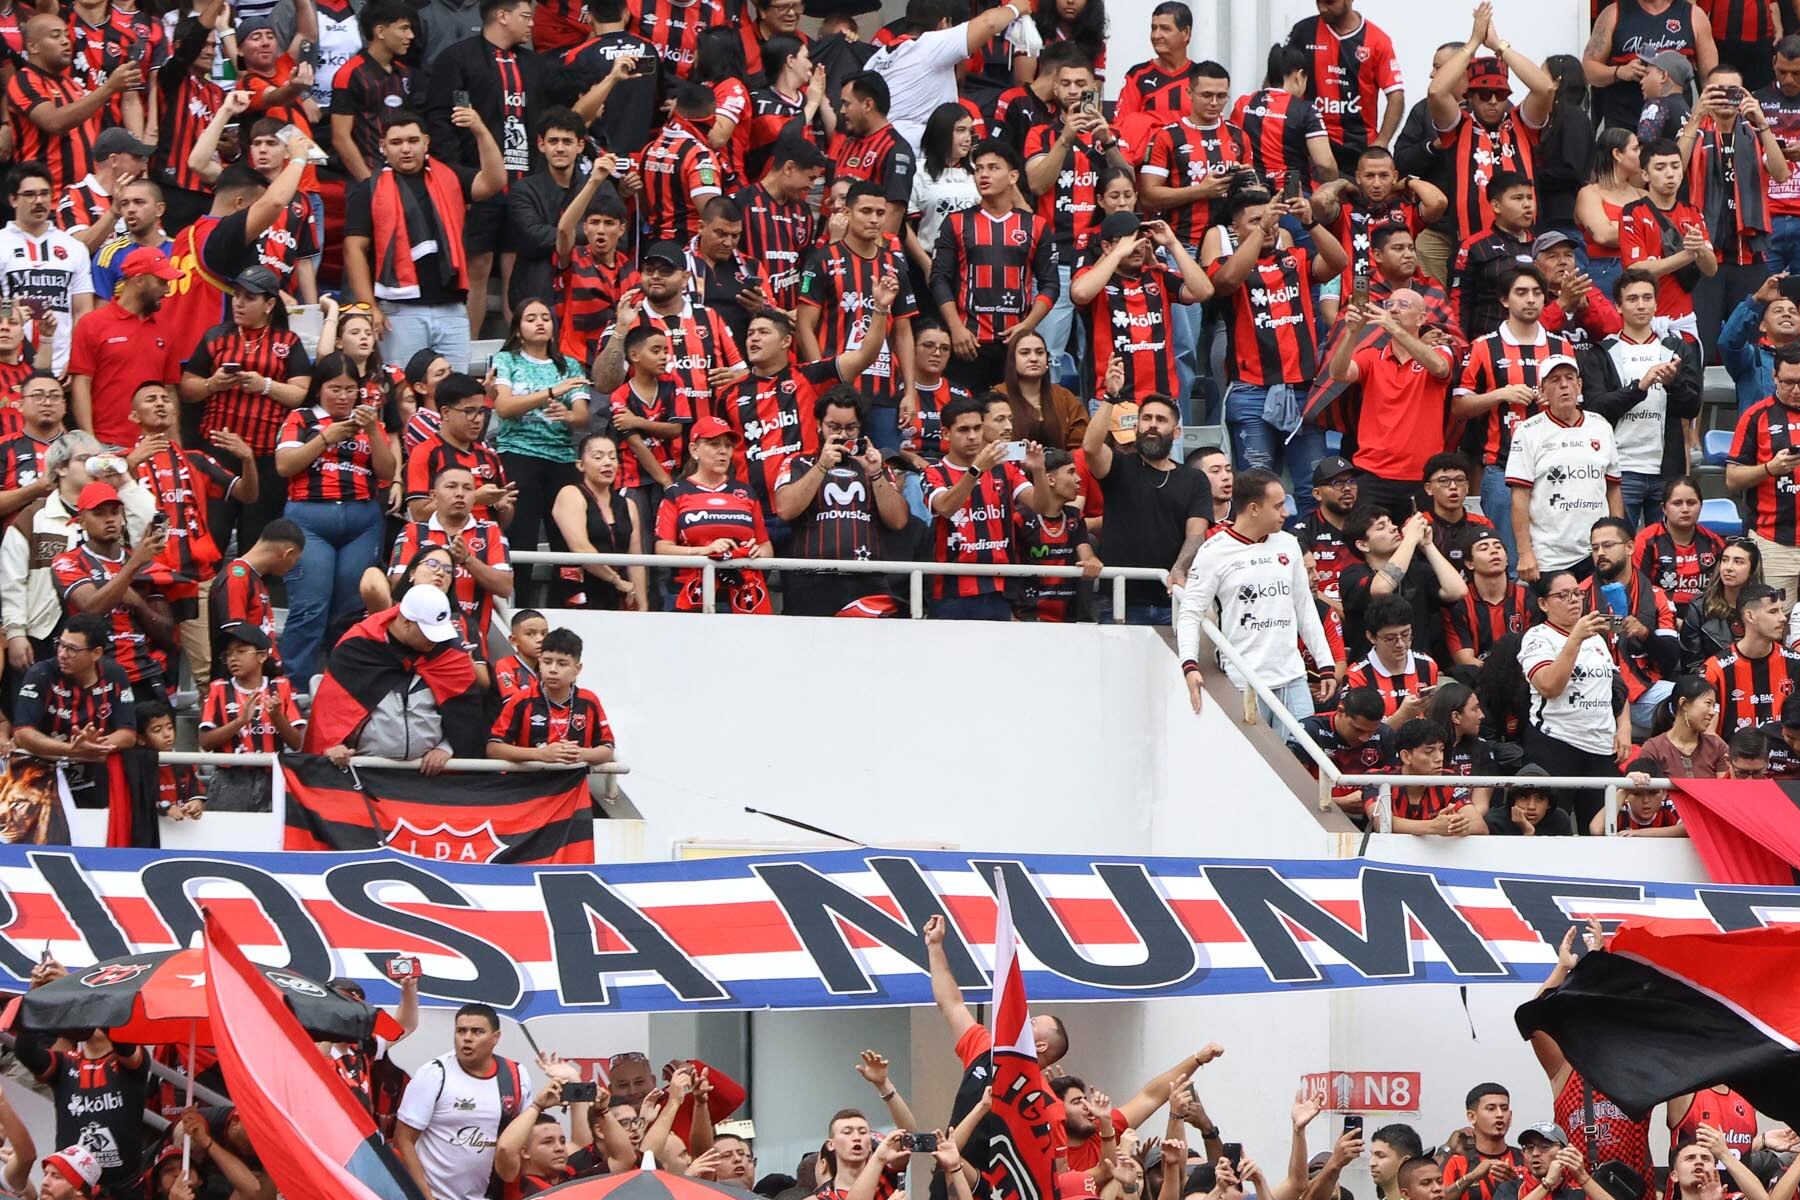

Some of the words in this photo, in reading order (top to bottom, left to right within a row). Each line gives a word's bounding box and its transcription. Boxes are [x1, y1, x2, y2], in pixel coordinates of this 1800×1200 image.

[1315, 95, 1359, 114] Claro
[12, 271, 71, 288] Mutual
[975, 305, 994, 313] Banco
[996, 305, 1019, 314] General
[672, 354, 712, 372] kölbi
[1626, 411, 1661, 421] medism
[1568, 465, 1603, 480] kölbi
[1560, 499, 1602, 510] medismart
[708, 513, 753, 521] movistar
[816, 509, 871, 521] movistar
[969, 504, 1005, 522] kölbi
[960, 539, 1009, 551] medismart
[1718, 655, 1738, 668] Mobil
[411, 843, 477, 860] LDA
[1365, 1077, 1410, 1105] N8
[83, 1093, 124, 1114] kölbi
